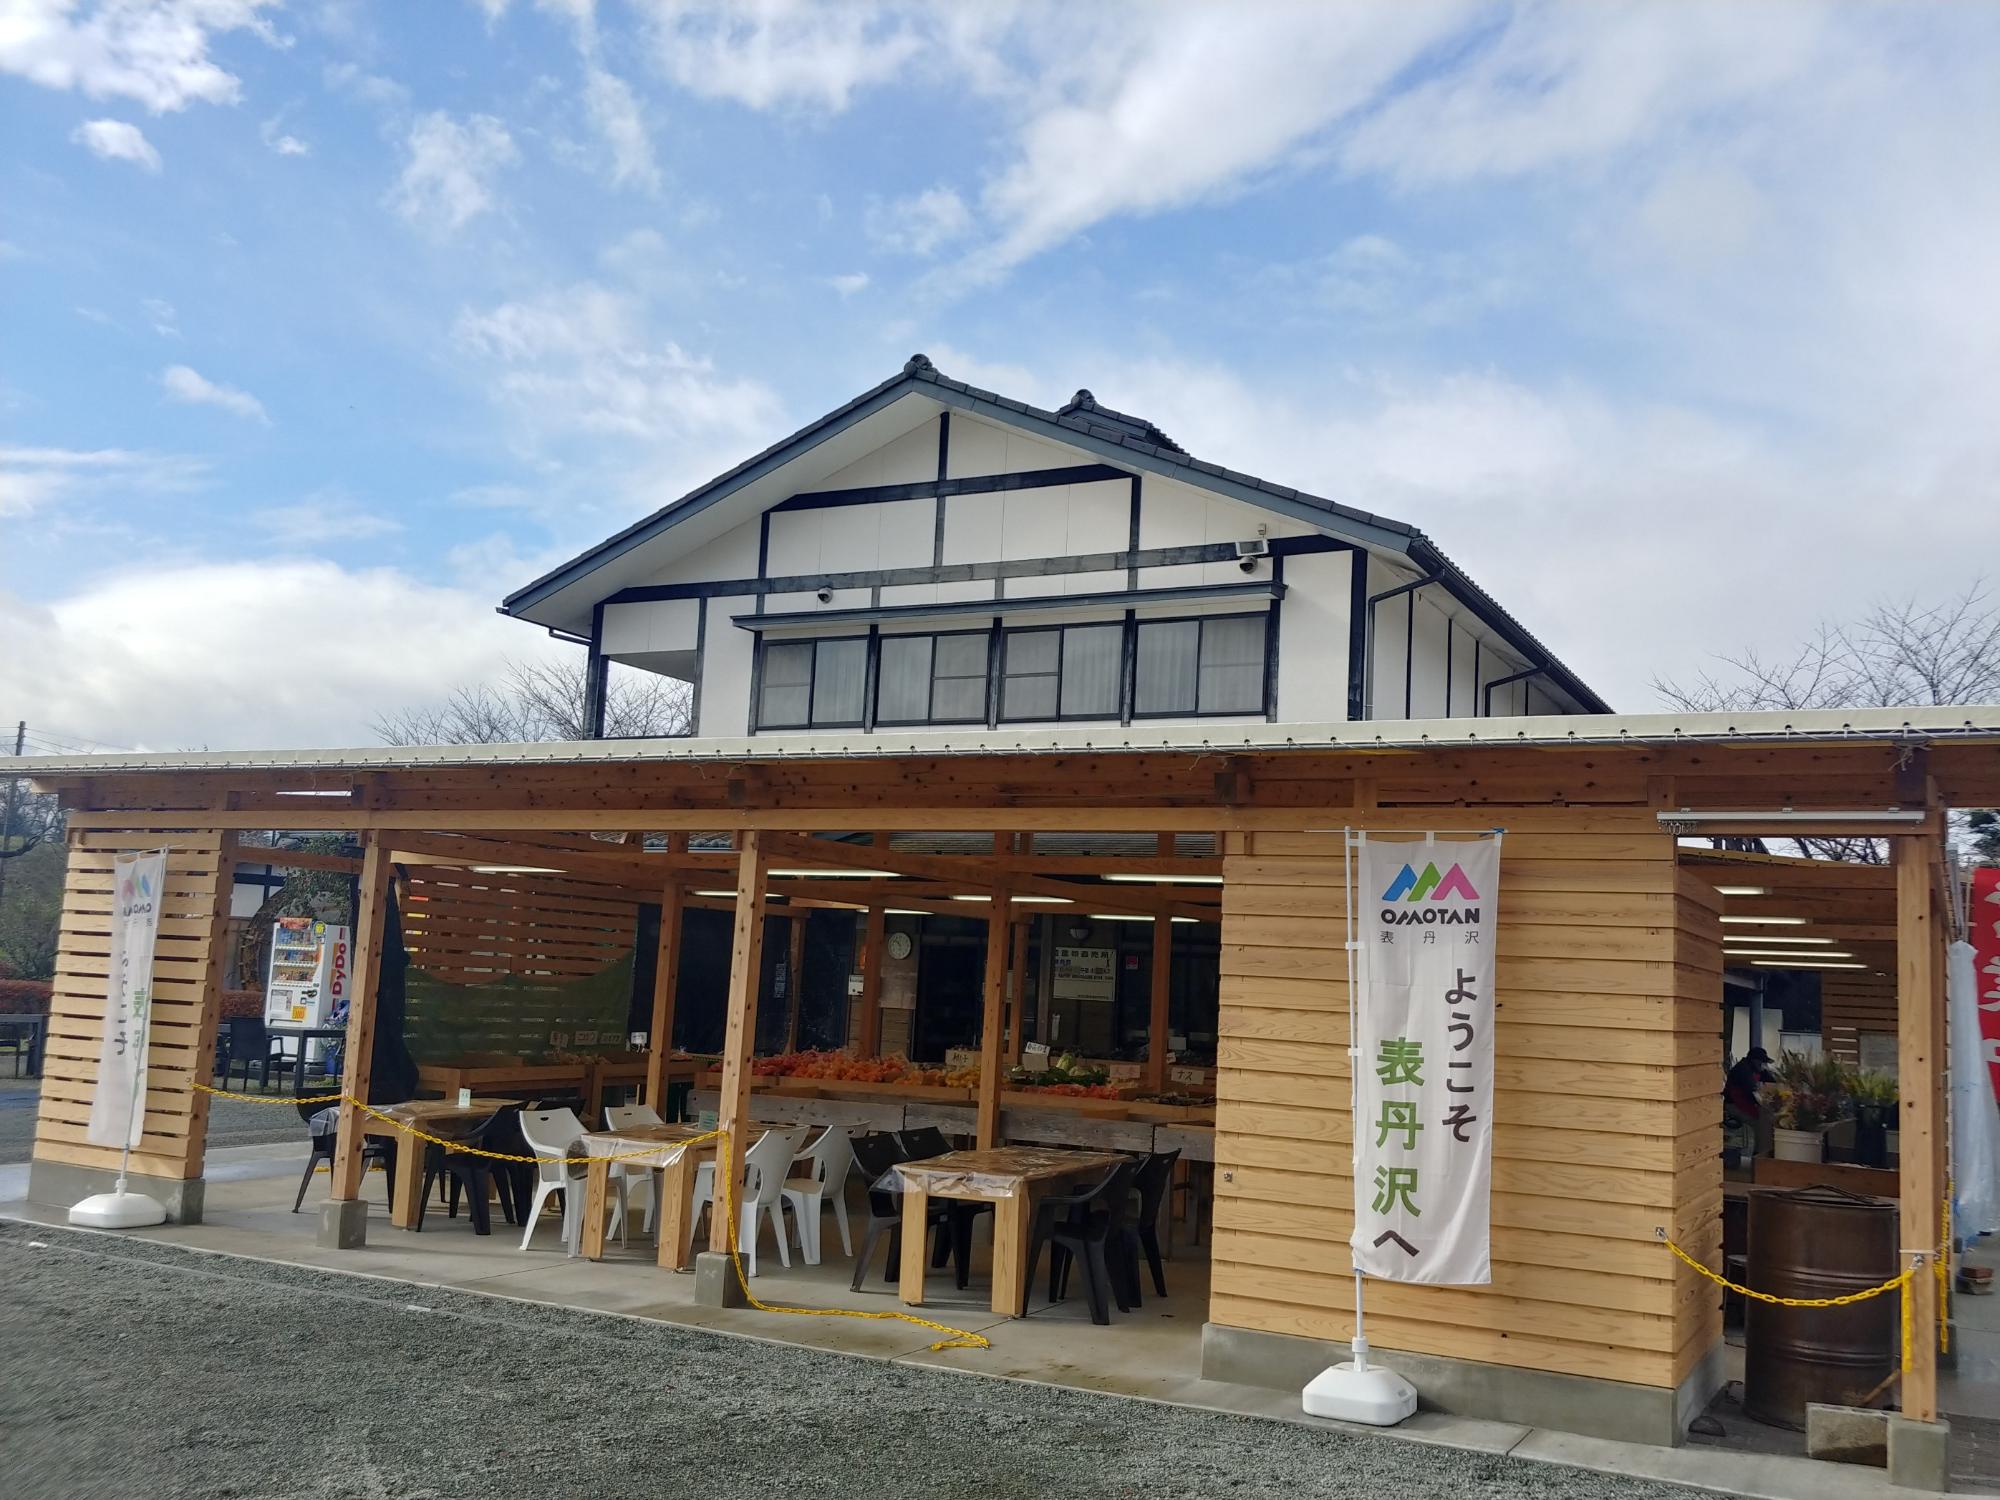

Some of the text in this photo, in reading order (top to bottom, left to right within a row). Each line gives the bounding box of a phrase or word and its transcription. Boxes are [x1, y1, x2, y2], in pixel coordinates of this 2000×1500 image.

[1381, 908, 1480, 925] OMOTAN
[1380, 930, 1479, 944] 表丹沢
[332, 943, 347, 995] DyDo
[1442, 968, 1477, 1143] ようこそ
[1177, 1070, 1193, 1081] ナス
[1371, 1037, 1425, 1257] 表丹沢へ
